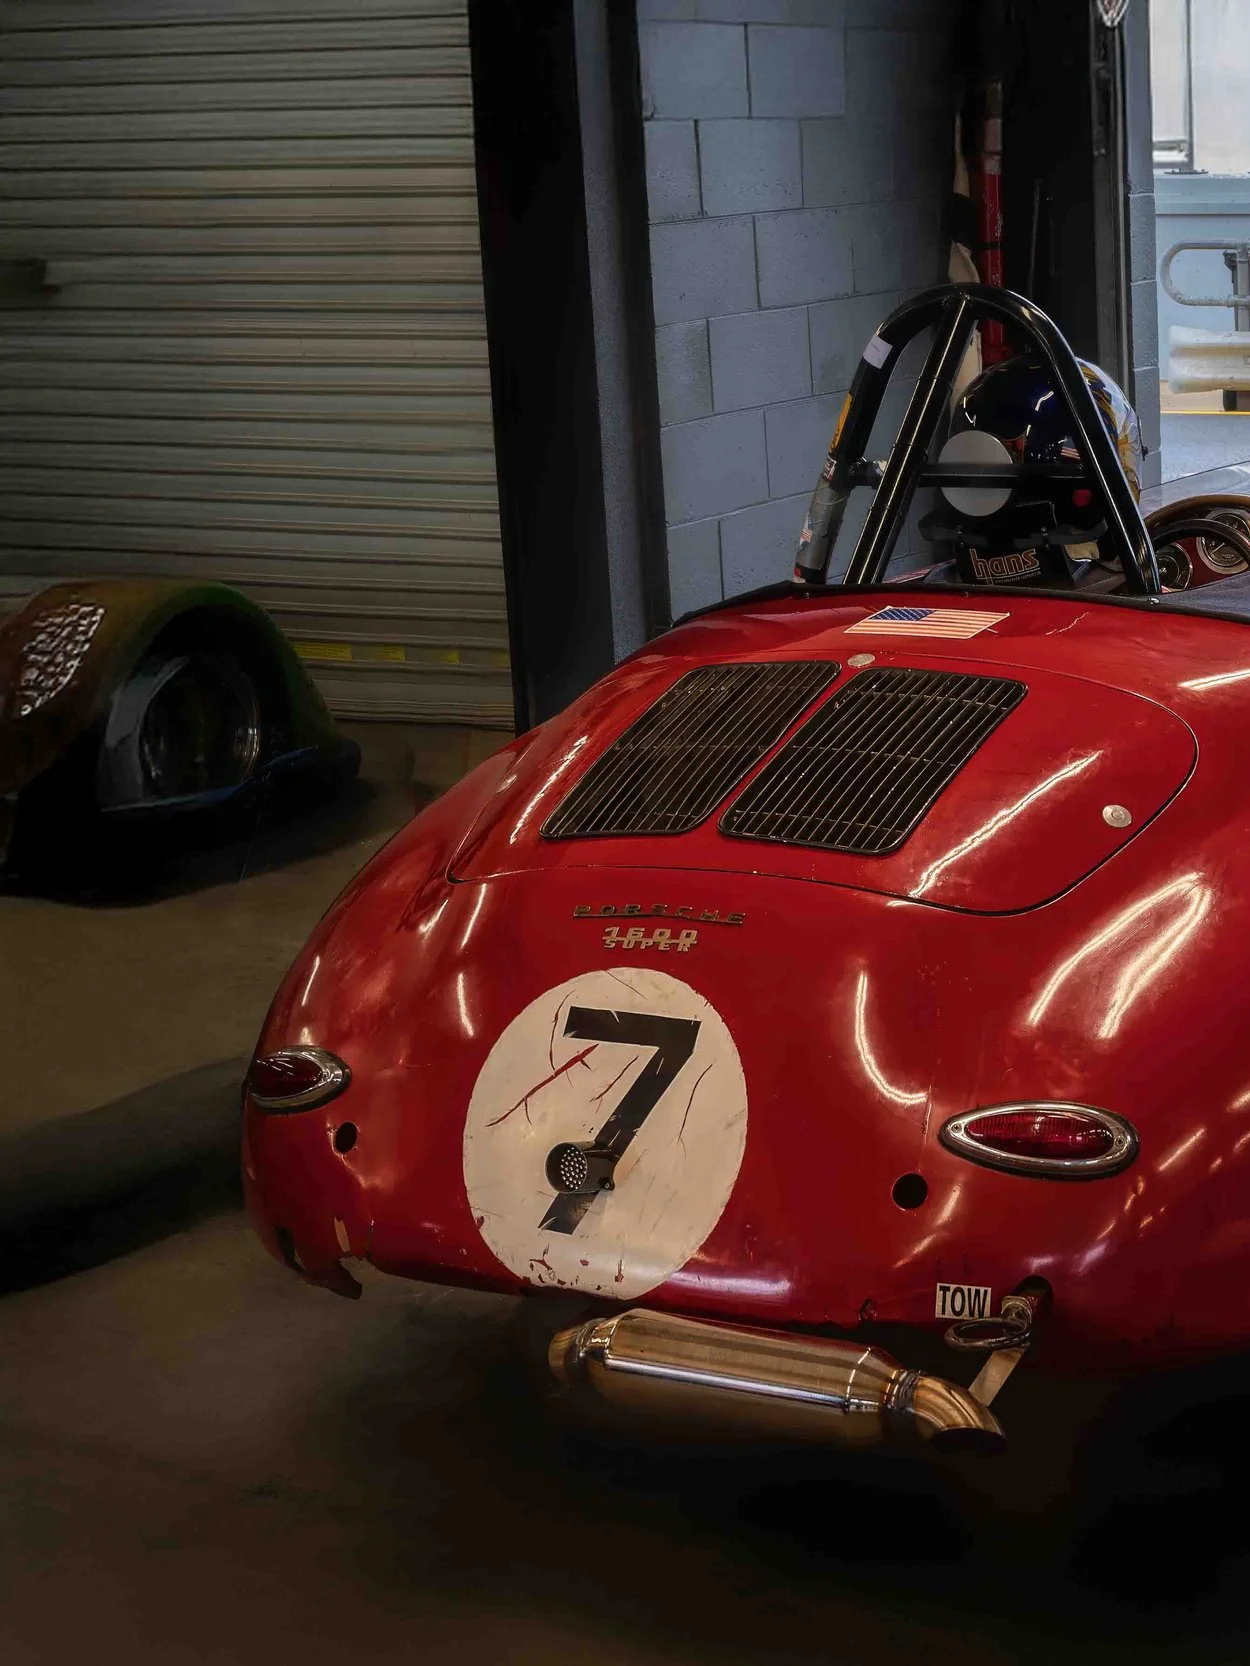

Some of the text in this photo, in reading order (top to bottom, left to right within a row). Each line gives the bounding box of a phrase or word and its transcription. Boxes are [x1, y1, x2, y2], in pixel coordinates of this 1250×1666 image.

[968, 548, 1040, 586] hans
[573, 903, 747, 924] PORSCHE
[603, 926, 698, 941] 1600
[603, 938, 692, 952] SUPER
[537, 1005, 702, 1235] 7
[938, 1285, 988, 1319] TOW
